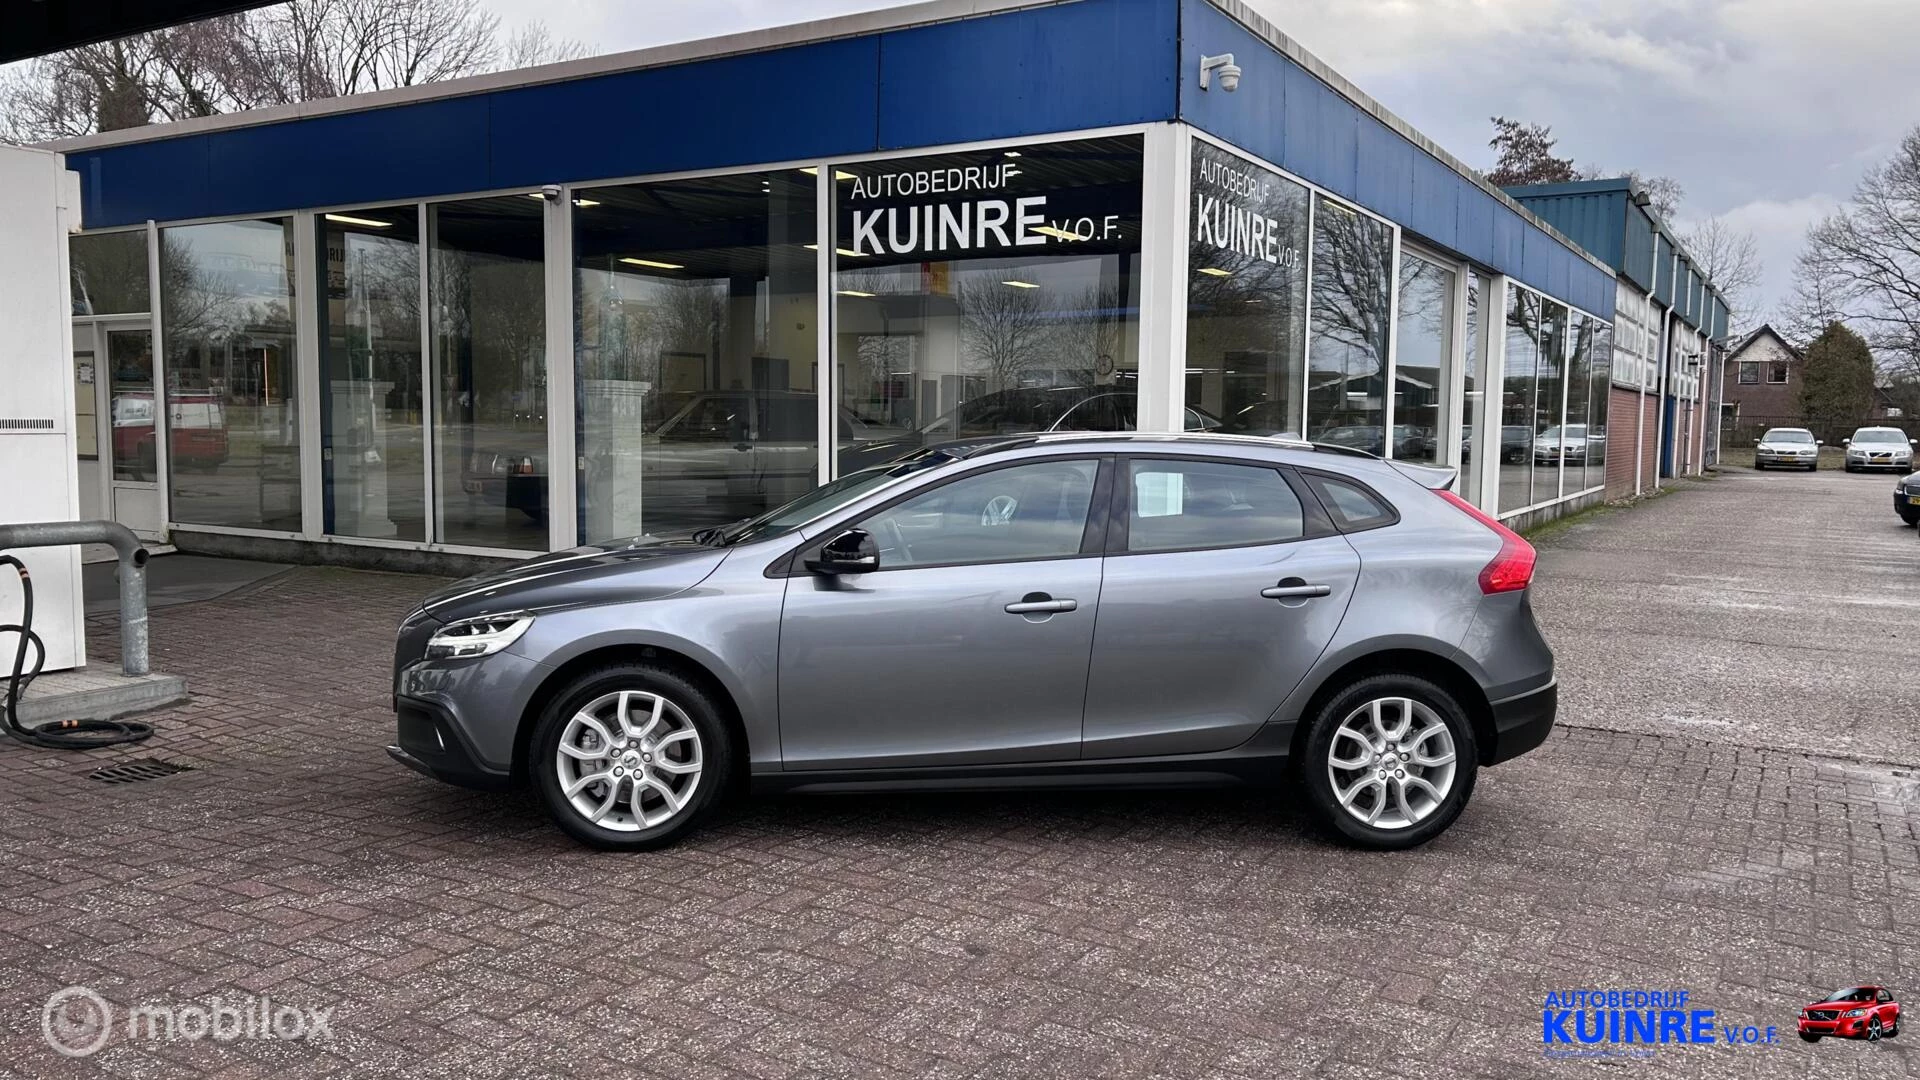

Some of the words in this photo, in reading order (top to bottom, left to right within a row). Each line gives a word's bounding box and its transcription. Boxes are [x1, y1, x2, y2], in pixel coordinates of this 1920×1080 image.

[851, 163, 1016, 200] AUTOBEDRIJF
[1200, 158, 1270, 203] AUTOBEDRIJF
[853, 195, 1047, 256] KUINRE
[1052, 215, 1122, 243] V.O.F.
[1198, 193, 1278, 264] KUINRE
